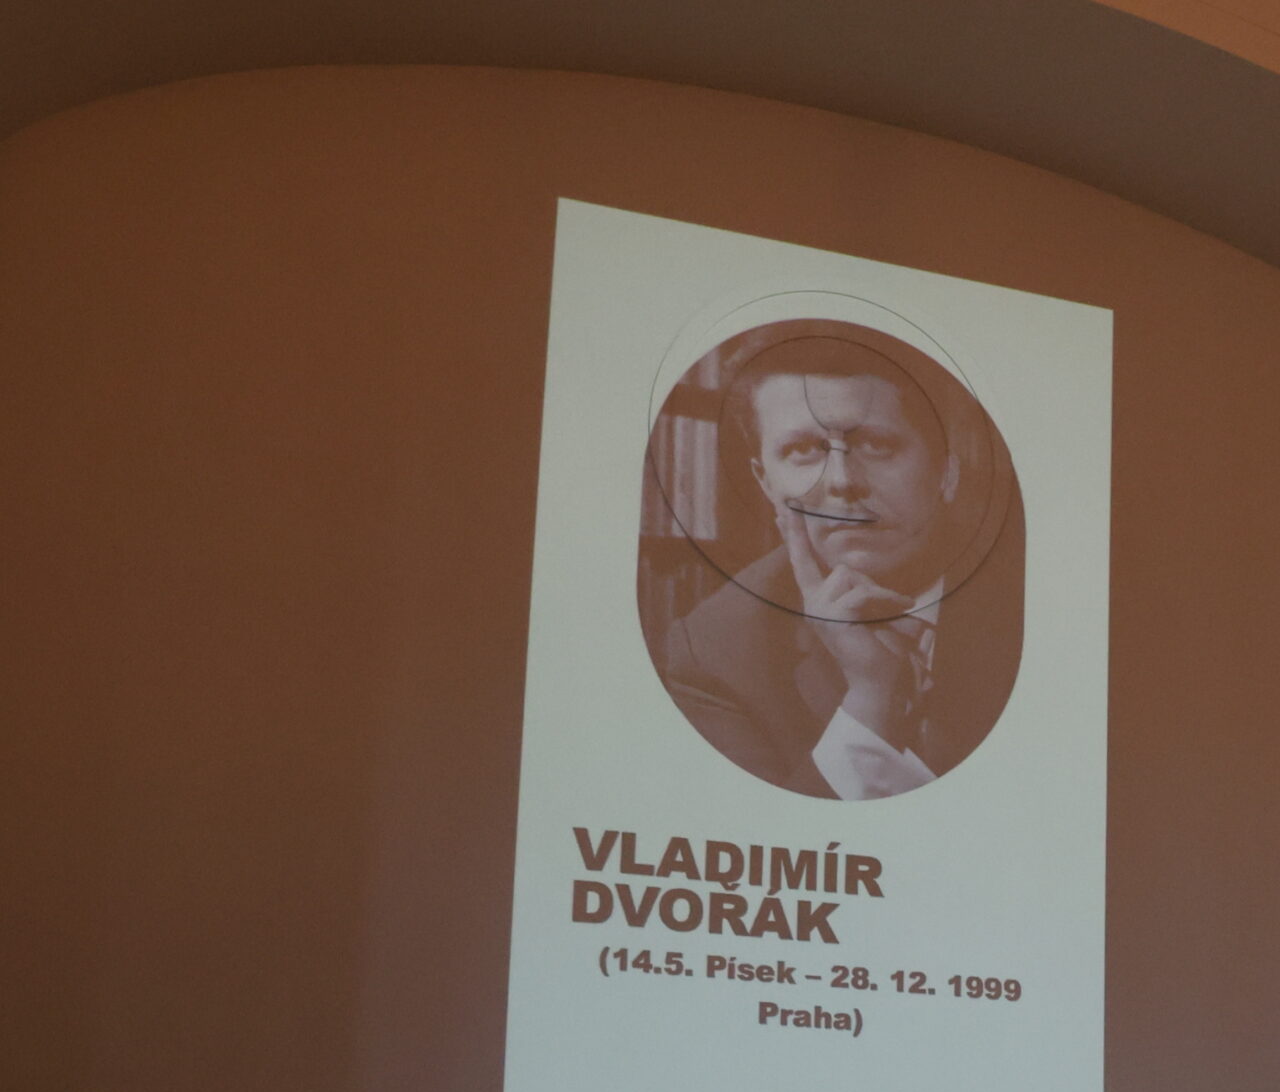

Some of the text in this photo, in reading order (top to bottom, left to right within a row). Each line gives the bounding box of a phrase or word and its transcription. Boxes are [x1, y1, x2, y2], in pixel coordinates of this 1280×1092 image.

[571, 826, 885, 899] VLADIMÍR
[571, 879, 841, 945] DVOŘÁK
[598, 945, 695, 978] (14.5.
[706, 954, 797, 985] Písek
[830, 964, 879, 992] 28.
[890, 969, 937, 996] 12.
[947, 974, 1022, 1002] 1999
[758, 1001, 864, 1038] Praha)
